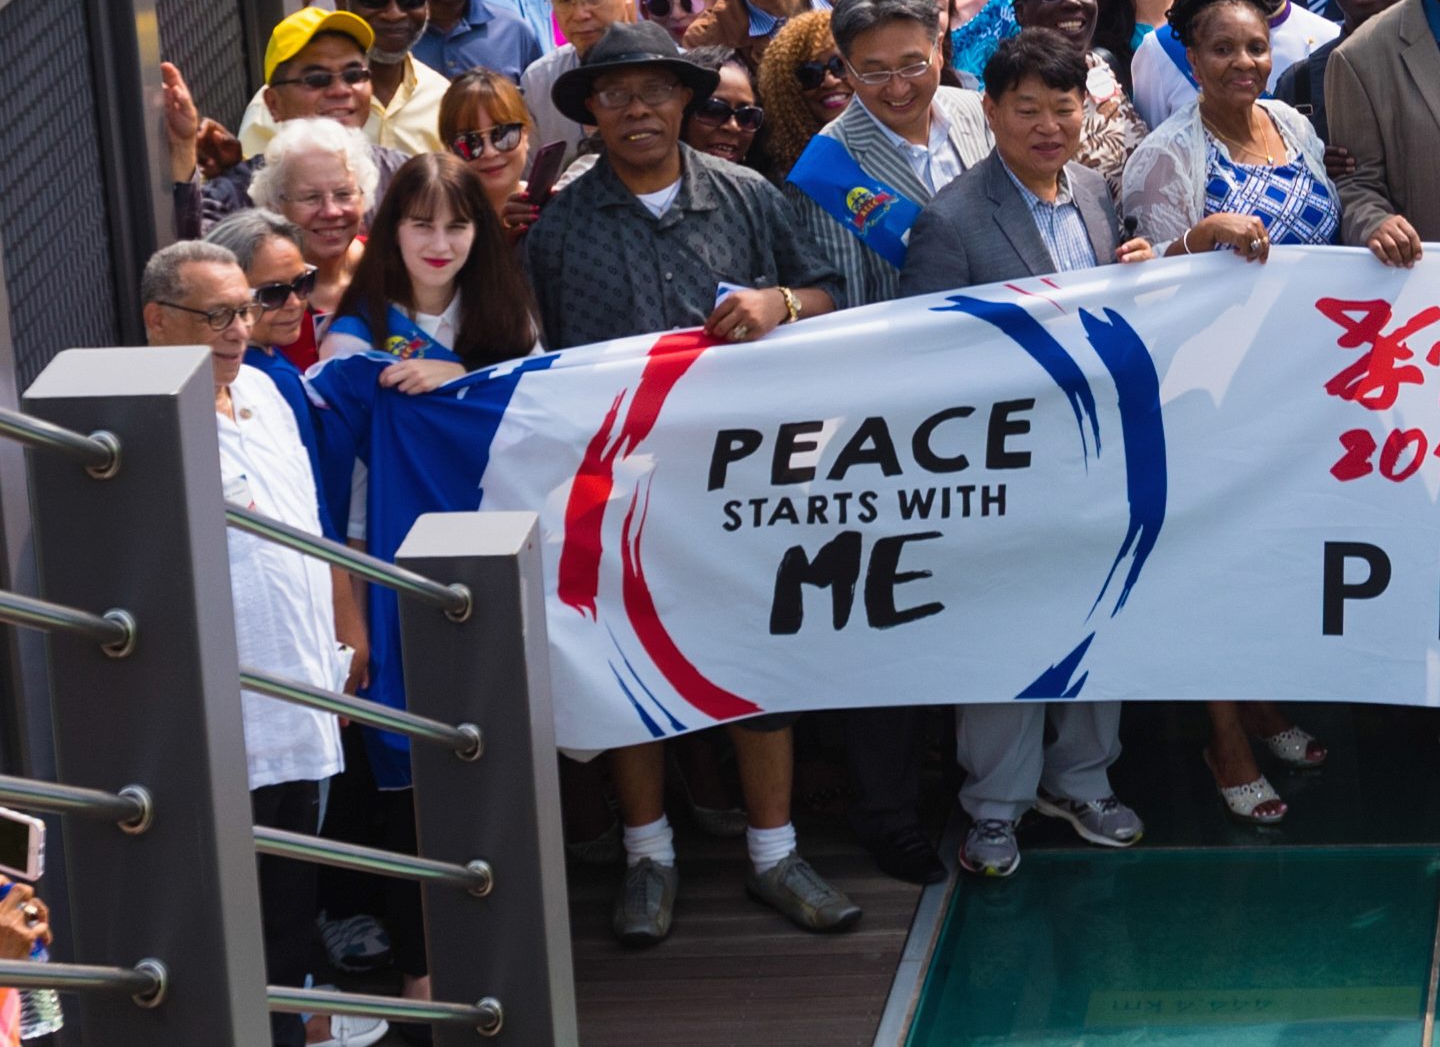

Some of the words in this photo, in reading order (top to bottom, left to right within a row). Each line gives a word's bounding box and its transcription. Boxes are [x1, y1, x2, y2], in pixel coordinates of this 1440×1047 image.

[707, 397, 1036, 492] PEACE
[722, 490, 879, 532] STARTS
[897, 483, 1007, 521] WITH
[769, 530, 946, 635] ME
